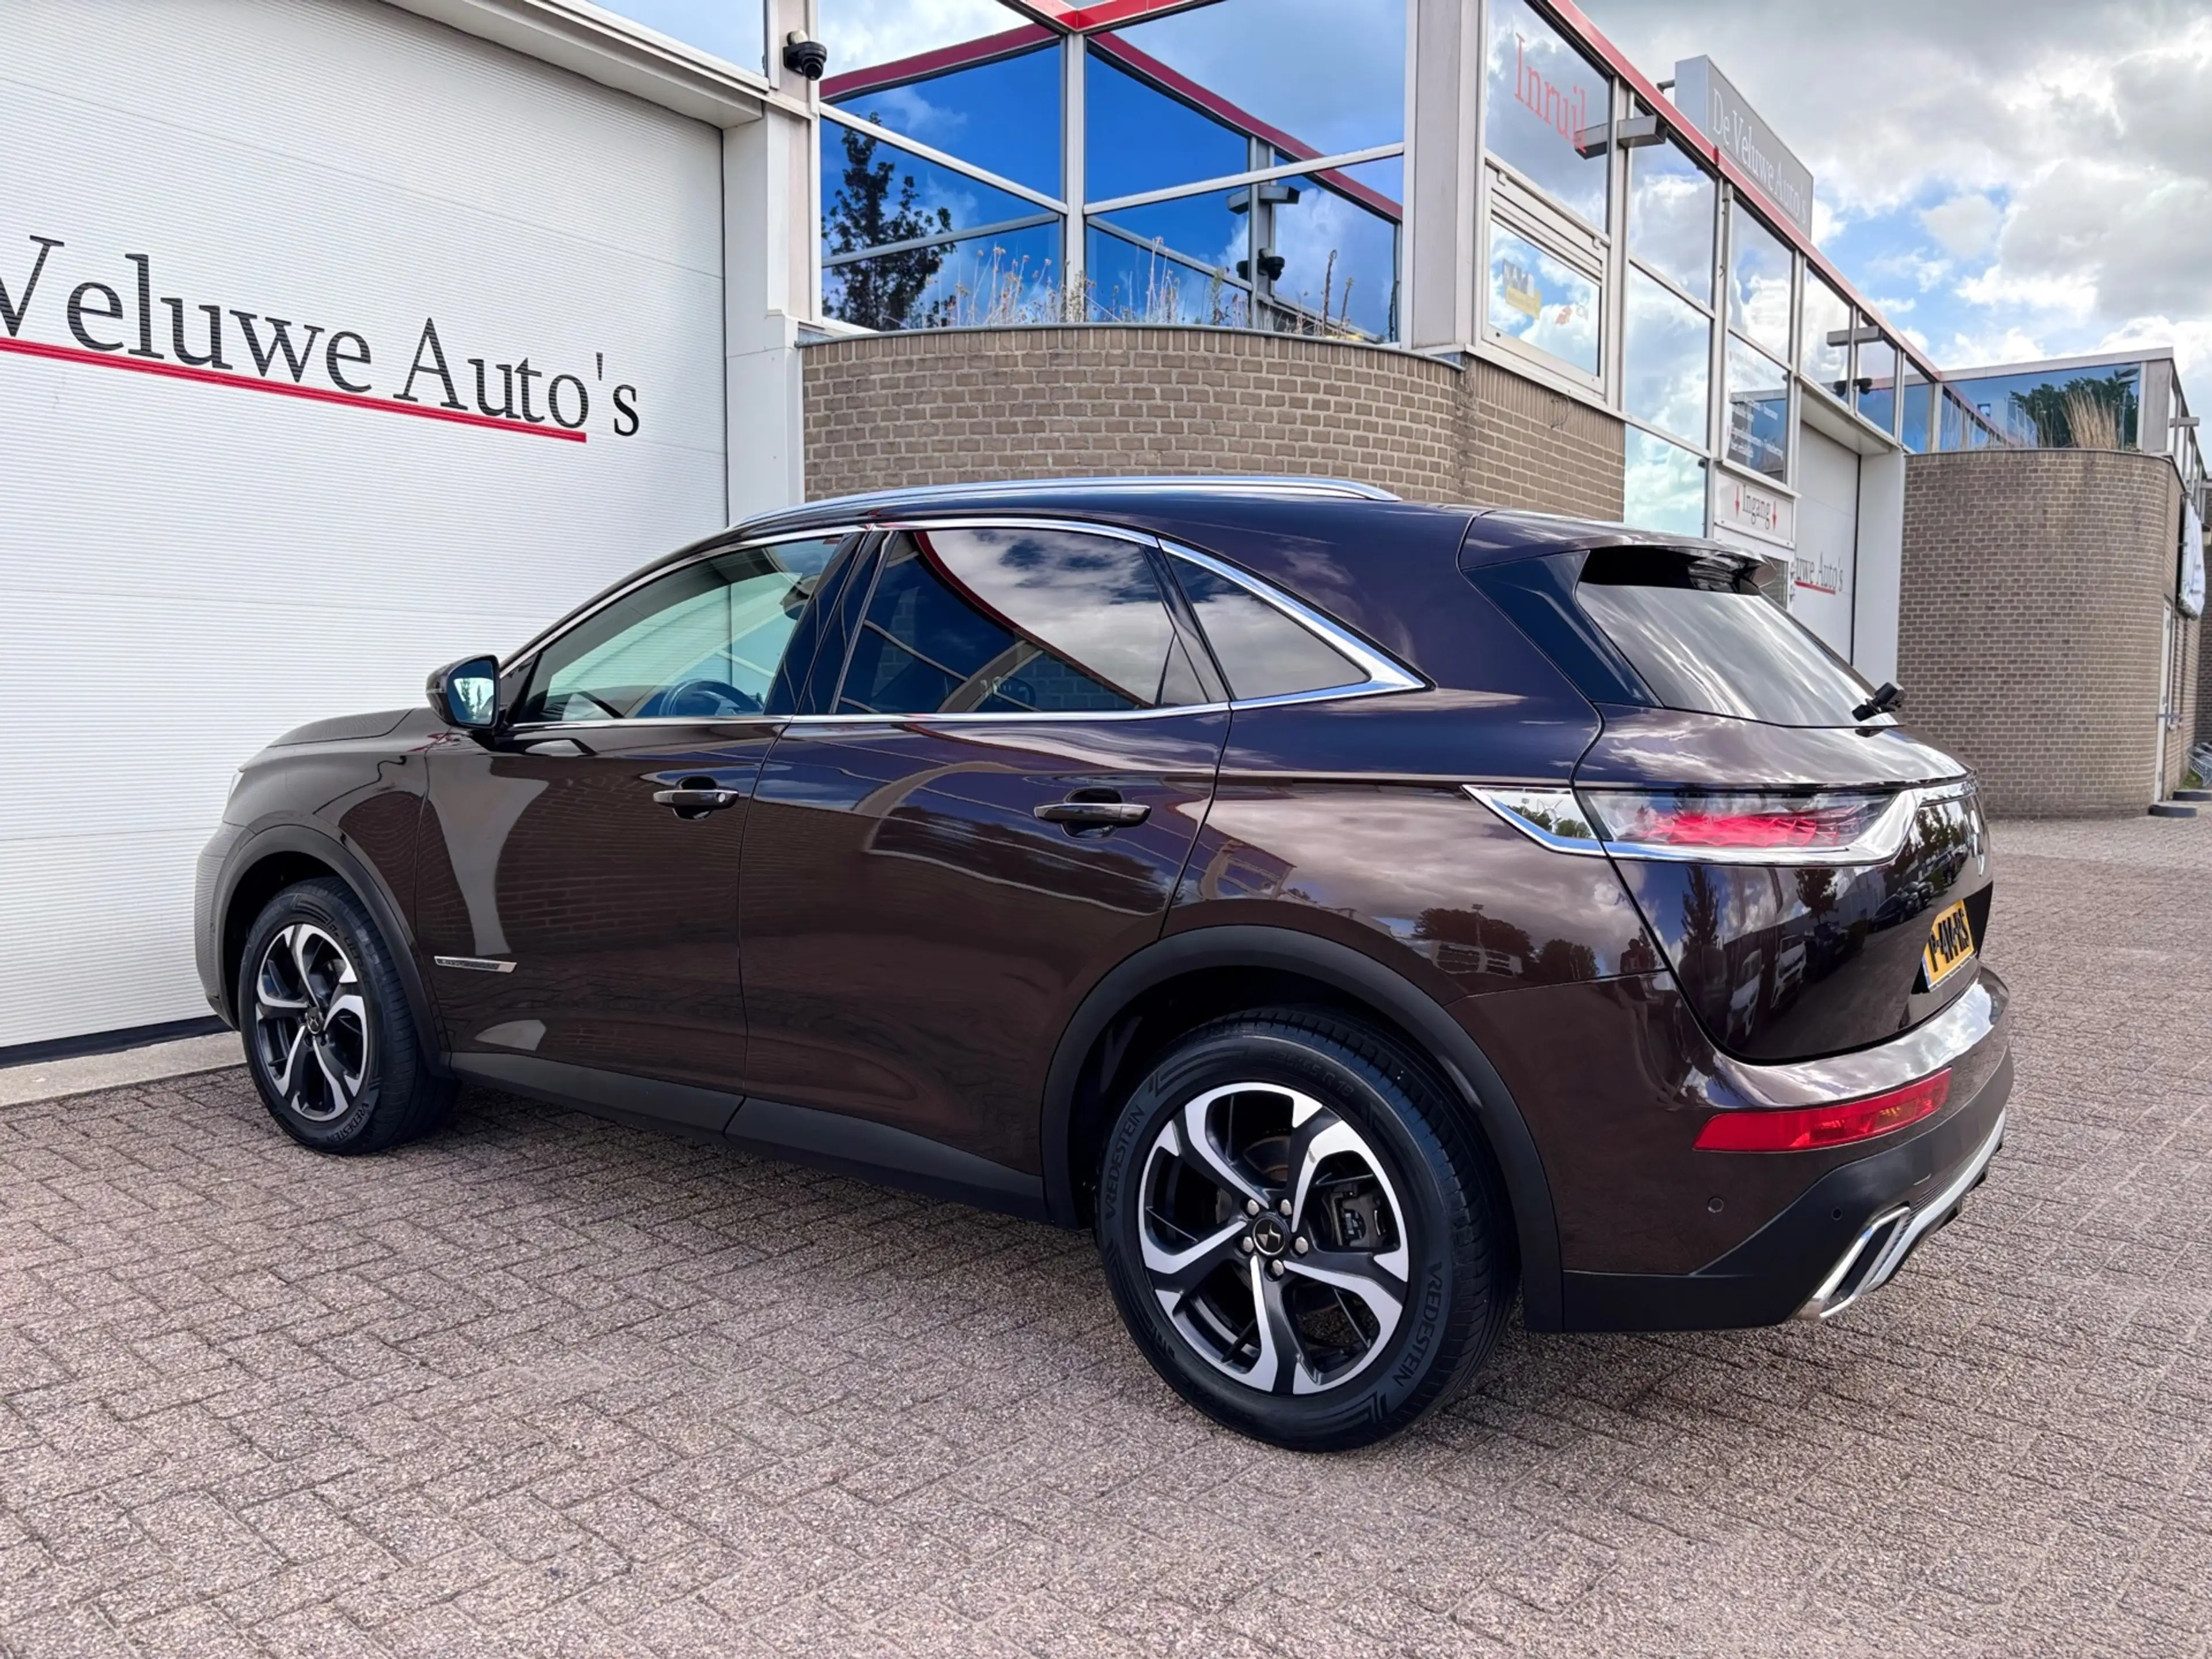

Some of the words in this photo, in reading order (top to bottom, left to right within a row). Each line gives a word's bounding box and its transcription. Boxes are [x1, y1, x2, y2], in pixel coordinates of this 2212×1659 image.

[1513, 33, 1587, 154] Inruil
[1713, 87, 1730, 145] De
[1733, 109, 1774, 191] Veluwe
[1774, 161, 1806, 225] Auto's
[0, 234, 373, 394] Veluwe
[393, 316, 641, 437] Auto's
[1742, 484, 1771, 530] Ingang
[1816, 551, 1843, 592] Auto's
[1105, 1104, 1146, 1221] VREDESTEIN
[1392, 1261, 1445, 1387] VREDESTEIN
